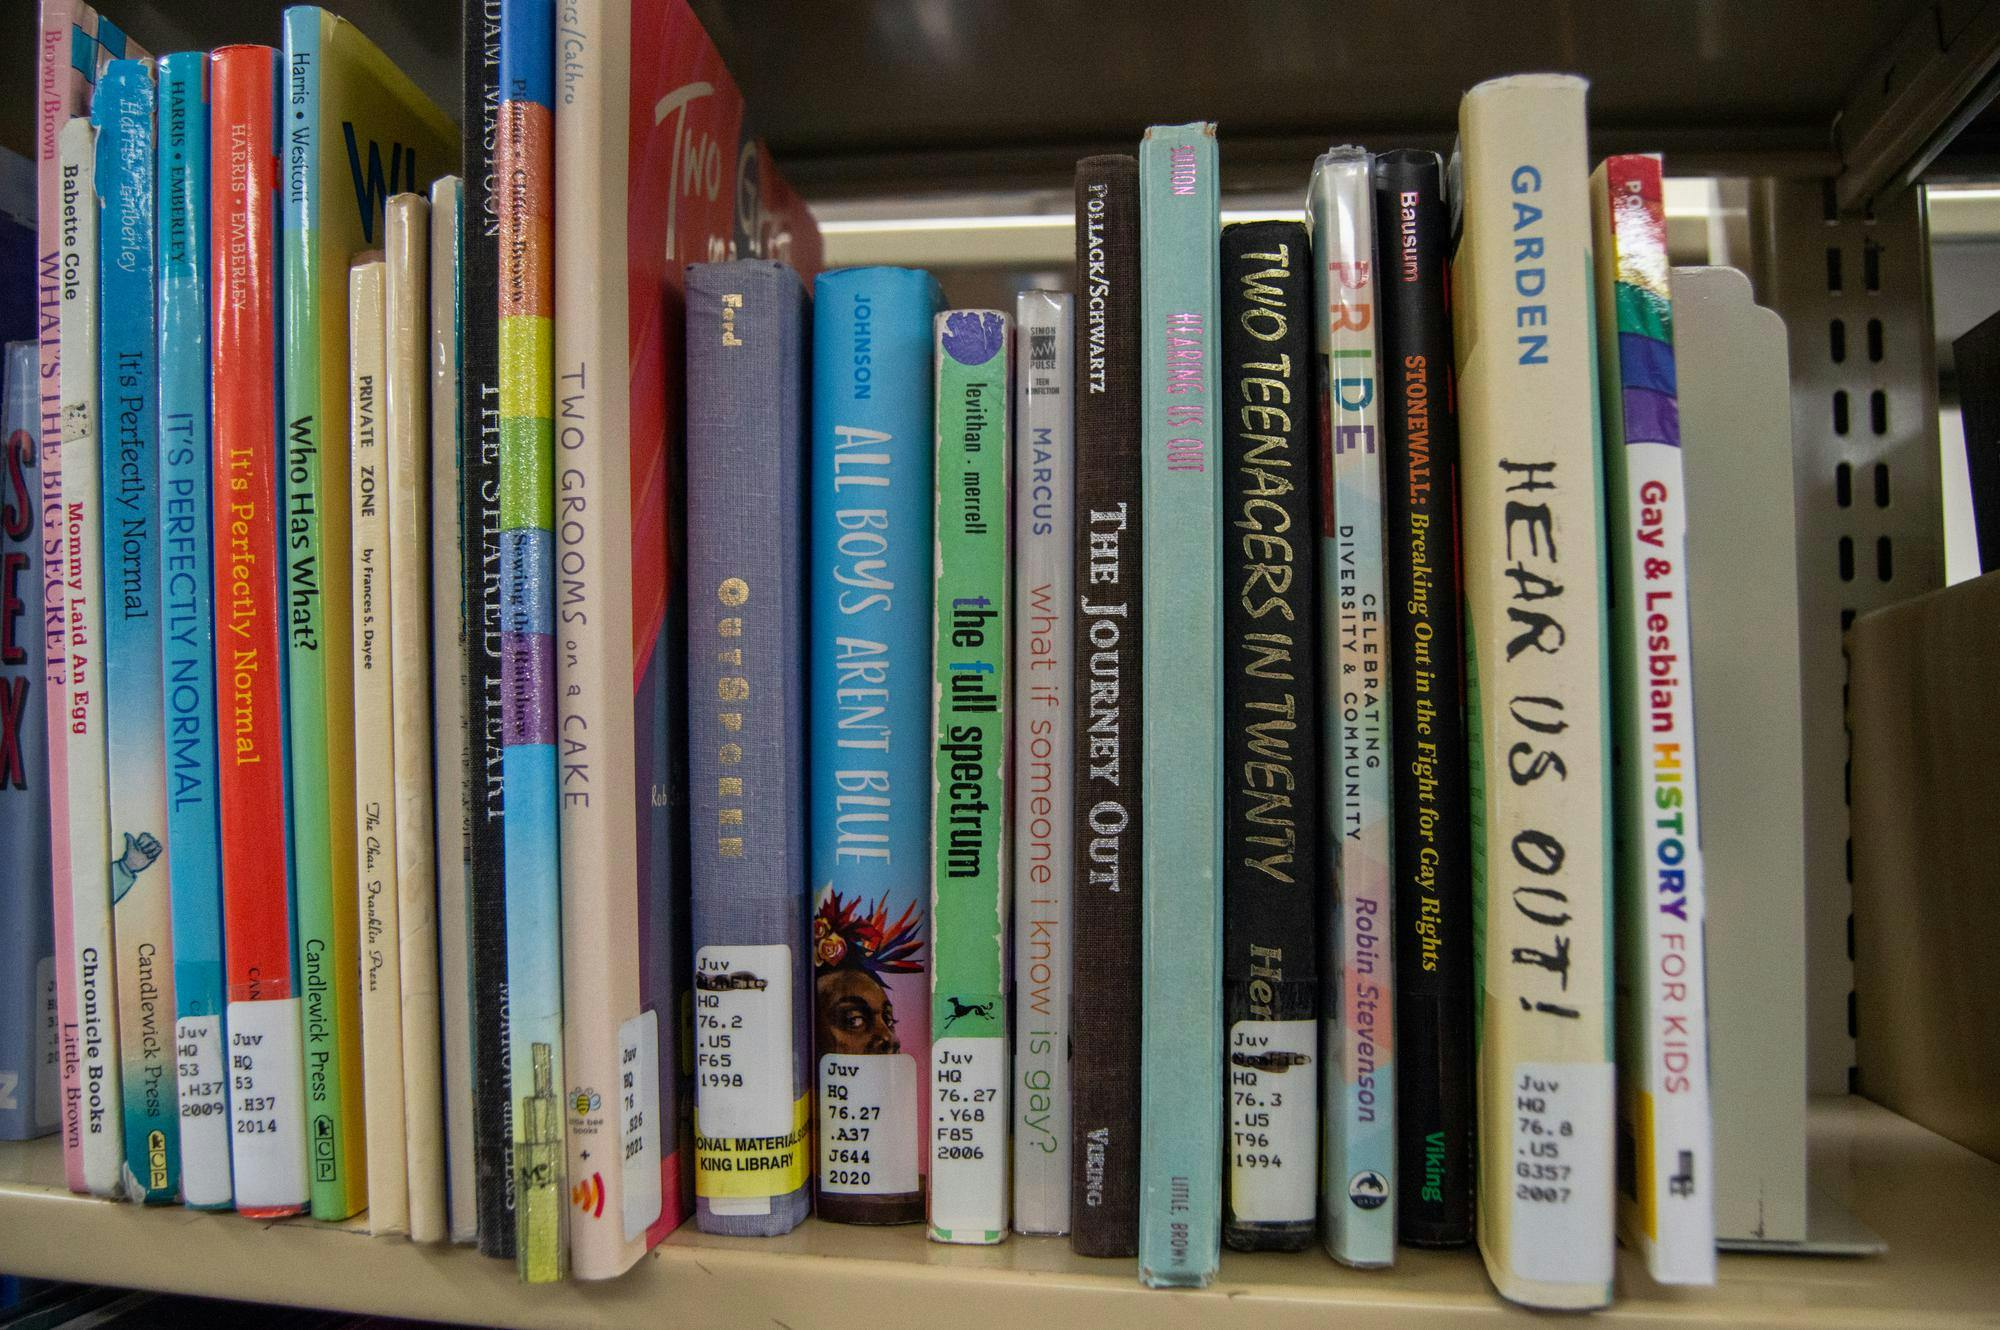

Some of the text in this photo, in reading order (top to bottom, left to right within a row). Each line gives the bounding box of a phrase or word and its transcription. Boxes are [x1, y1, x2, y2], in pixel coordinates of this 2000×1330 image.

[42, 29, 63, 161] Brown/Brown
[292, 53, 310, 204] Harris Westcott
[170, 80, 186, 264] HARRIS EMBERLEY
[655, 81, 721, 261] TWO
[230, 124, 247, 309] HARRIS EMBERLEY
[62, 163, 81, 301] Babette Cole
[1401, 191, 1418, 282] Bausum
[1511, 165, 1548, 366] GARDEN
[1087, 184, 1110, 394] POLLACK/SCHWARTZ
[1031, 327, 1056, 335] SIMON
[854, 294, 871, 399] JOHNSON
[1031, 361, 1056, 369] PULSE
[1328, 260, 1376, 454] PRIDE
[1167, 313, 1204, 473] HEARING US OUT
[360, 375, 375, 517] PRIVATE ZONE
[965, 383, 987, 534] levithan merrell
[117, 352, 148, 620] It's Perfectly Normal
[1033, 428, 1052, 536] MARCUS
[289, 416, 319, 651] Who Has What?
[1234, 243, 1296, 883] TWO TEENAGERS IN TWENTY
[43, 472, 66, 685] BIG SECRET?
[561, 362, 589, 809] TWO GROOMS on a CAKE
[167, 413, 202, 812] IT'S PERFECTLY NORMAL
[229, 448, 260, 766] It's Perfectly Normal
[67, 502, 89, 736] Mommy Laid An Egg
[361, 568, 375, 670] Frances Dayee
[834, 425, 894, 865] ALL BOYS BLUE
[1405, 355, 1442, 972] STONEWALL: Breaking Out in the Fight for Gay Rights
[1340, 526, 1360, 841] DIVERSITY COMMUNITY
[1362, 594, 1380, 768] CELEBRATING
[1081, 502, 1129, 892] THE JOURNEY OUT
[941, 596, 997, 878] the full spectrum
[1499, 457, 1581, 1019] HEAR US OUT!
[1637, 480, 1689, 1095] Gay & Lesbian HISTORY FOR KIDS
[1024, 585, 1059, 1153] what if someone know is gay?
[368, 881, 383, 992] Franklin Press
[698, 958, 729, 970] Juv
[698, 995, 719, 1008] HQ
[1355, 897, 1379, 1122] Robin Stevenson
[138, 942, 163, 1117] Candlewick Press
[306, 939, 329, 1101] Candlewick Press
[699, 1016, 742, 1028] 76.2
[83, 948, 104, 1134] Chronicle Books
[178, 1026, 208, 1039] Juv
[233, 1034, 263, 1046] Juv
[700, 1035, 731, 1048] .U5
[1234, 1033, 1268, 1046] Juv
[178, 1045, 198, 1057] HQ
[623, 1048, 637, 1064] Juv
[699, 1054, 731, 1067] F65
[938, 1052, 973, 1064] Juv
[179, 1064, 200, 1077] 53
[234, 1056, 253, 1070] HQ
[828, 1063, 859, 1076] Juv
[235, 1078, 253, 1089] 53
[702, 1074, 743, 1088] 1998
[938, 1070, 962, 1083] HQ
[1233, 1073, 1258, 1086] HQ
[1519, 1075, 1558, 1092] Juv
[64, 1023, 81, 1150] Little, Brown
[182, 1082, 224, 1096] .H37
[828, 1086, 848, 1100] HQ
[938, 1089, 997, 1102] 76.27
[181, 1103, 225, 1116] 2009
[238, 1098, 275, 1111] .H37
[1234, 1093, 1282, 1107] 76.3
[1518, 1097, 1545, 1113] HQ
[829, 1107, 881, 1120] 76.27
[939, 1109, 984, 1122] .Y68
[1234, 1114, 1269, 1127] .U5
[237, 1120, 277, 1134] 2014
[830, 1129, 869, 1141] .A37
[938, 1128, 973, 1141] F85
[1519, 1117, 1573, 1137] 76.8
[736, 1129, 800, 1151] MATERIALS
[1235, 1134, 1269, 1147] T96
[829, 1150, 870, 1163] J644
[938, 1147, 984, 1160] 2006
[1519, 1142, 1558, 1158] .U5
[701, 1152, 794, 1171] KING LIBRARY
[1236, 1154, 1282, 1168] 1994
[1421, 1131, 1445, 1202] Viking
[829, 1171, 870, 1184] 2020
[1517, 1184, 1571, 1203] 2007
